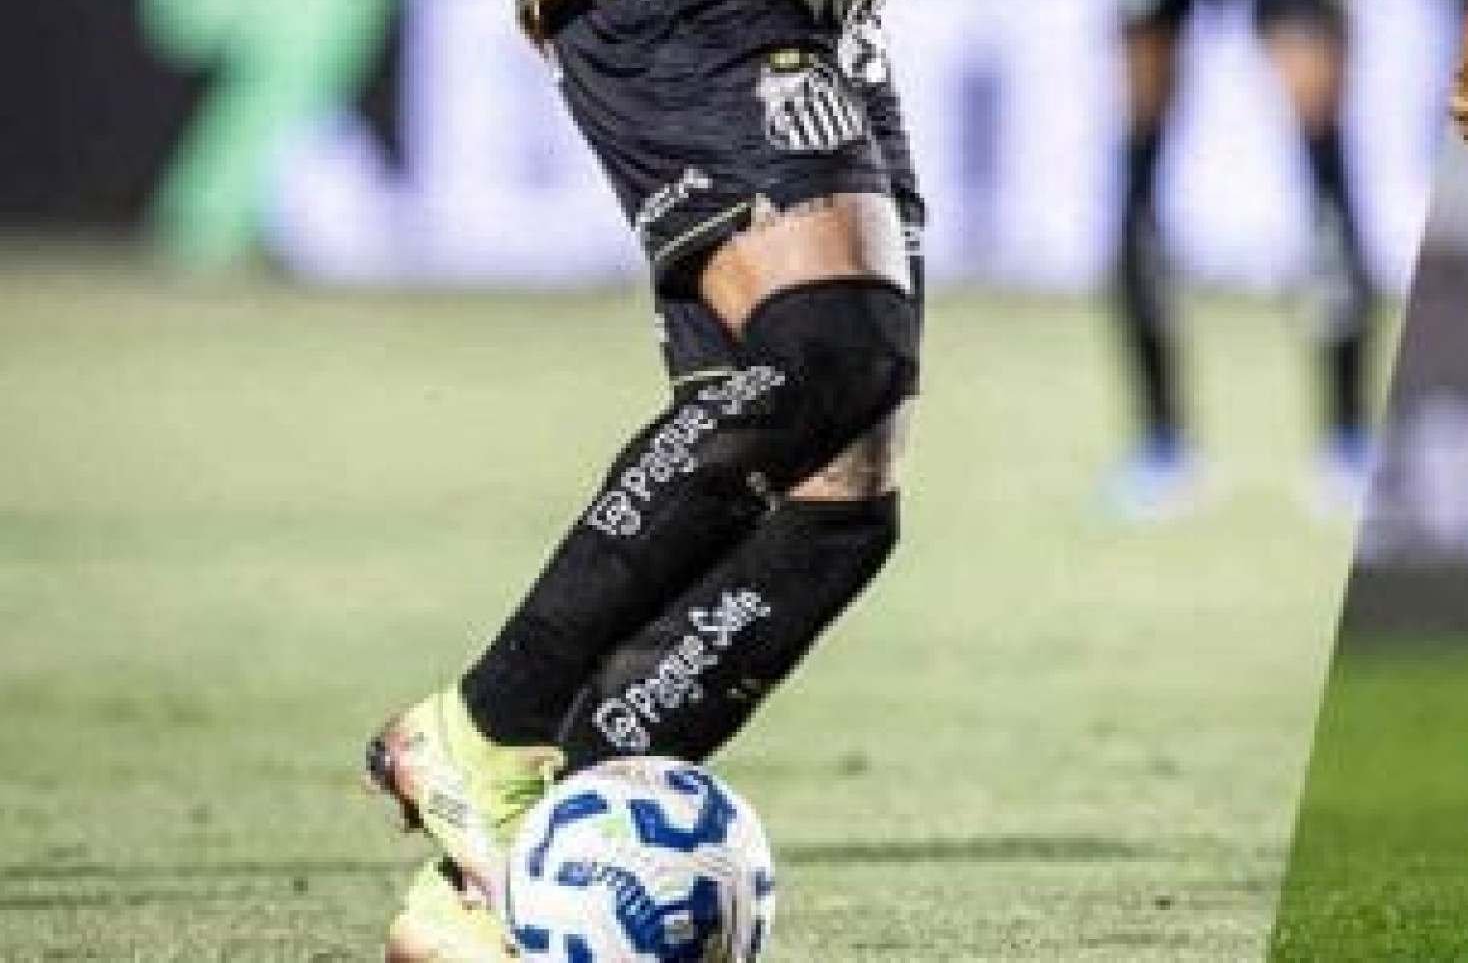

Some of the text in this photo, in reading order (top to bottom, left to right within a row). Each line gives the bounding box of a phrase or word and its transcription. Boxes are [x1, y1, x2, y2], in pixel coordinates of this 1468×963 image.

[620, 404, 714, 502] Pague
[624, 589, 771, 724] Pague Safe
